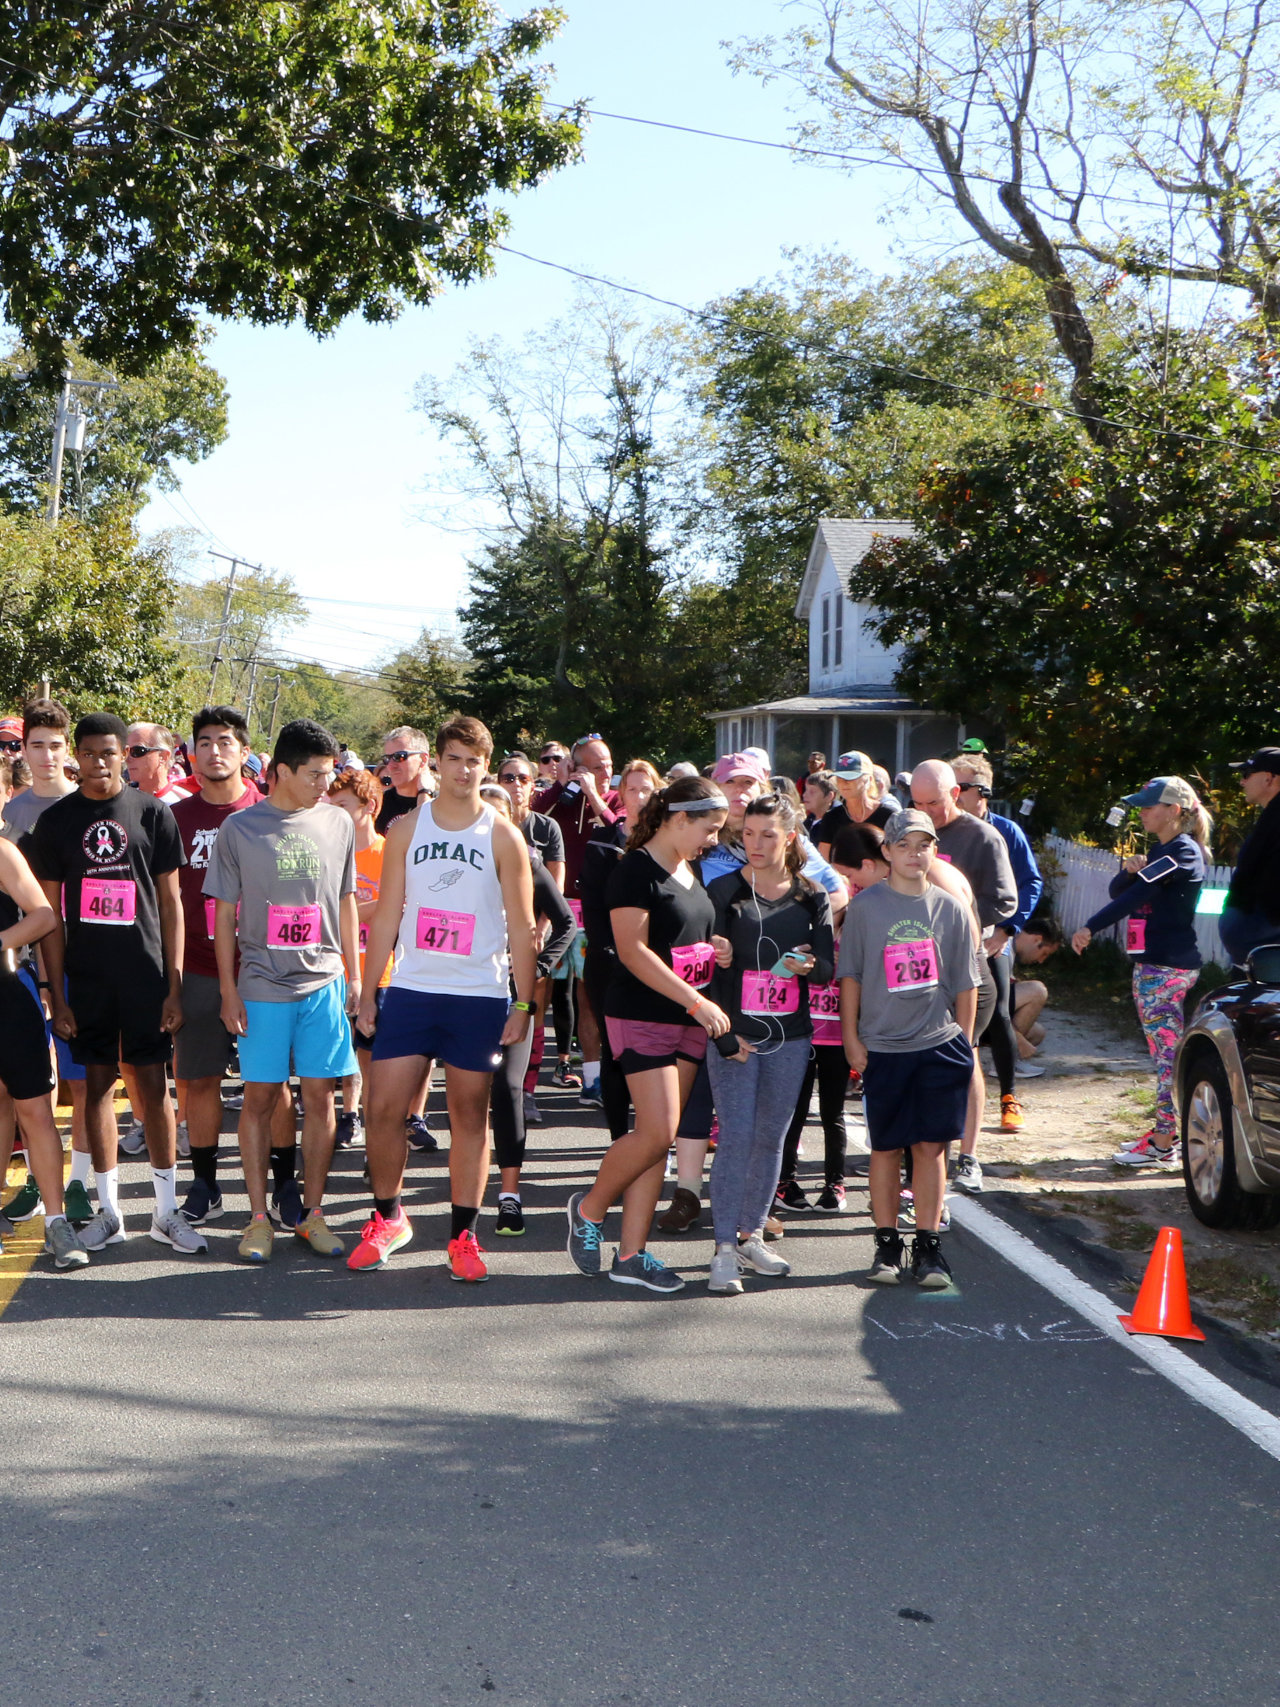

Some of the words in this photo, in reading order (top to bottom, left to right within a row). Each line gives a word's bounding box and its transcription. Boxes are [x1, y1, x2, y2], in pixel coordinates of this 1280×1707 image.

[300, 857, 320, 868] RUN
[414, 842, 485, 871] OMAC
[89, 897, 125, 917] 464
[278, 923, 311, 943] 462
[424, 926, 459, 951] 471
[683, 960, 710, 983] 260
[895, 959, 932, 983] 262
[757, 987, 787, 1004] 124
